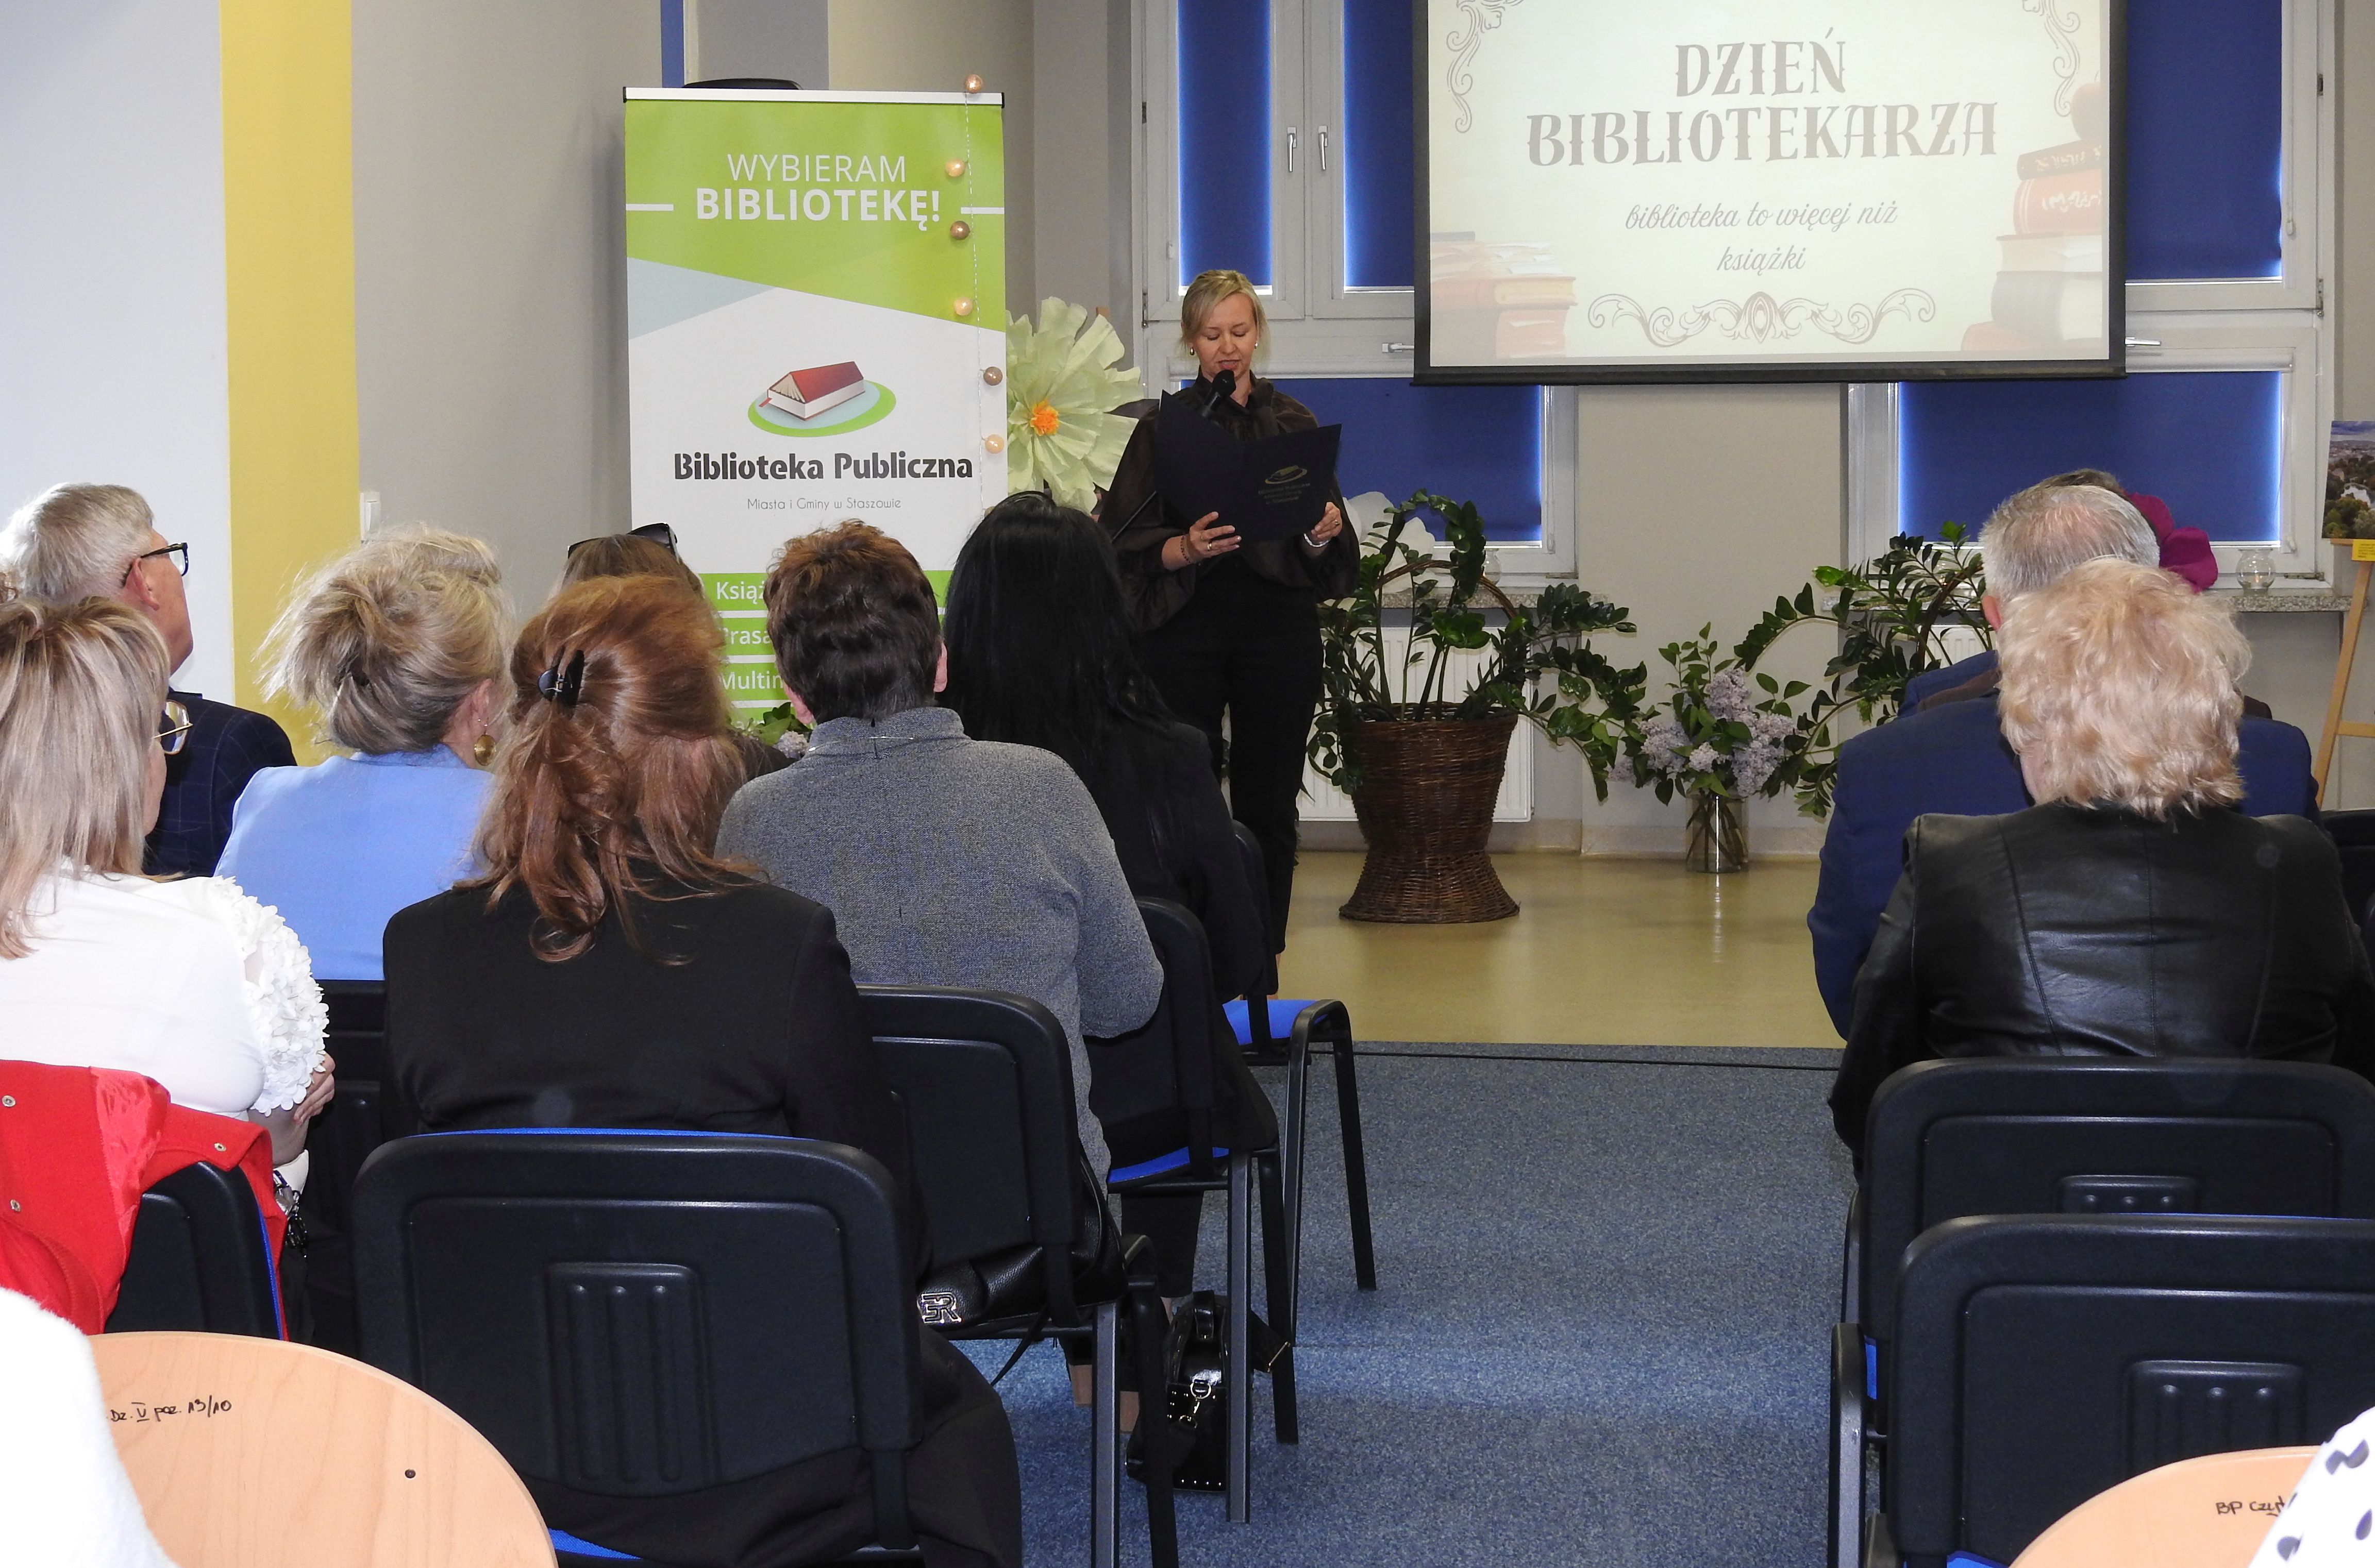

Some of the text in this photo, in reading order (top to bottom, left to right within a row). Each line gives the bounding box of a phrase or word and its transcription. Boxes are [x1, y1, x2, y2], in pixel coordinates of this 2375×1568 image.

[1675, 27, 1846, 97] DZIEŃ
[1527, 102, 1998, 166] BIBLIOTEKARZA
[727, 154, 906, 182] WYBIERAM
[697, 188, 940, 231] BIBLIOTEKĘ!
[1626, 200, 1898, 232] biblioteka to więcej niż
[1716, 245, 1806, 276] książki
[674, 451, 973, 480] Biblioteka Publiczna
[747, 498, 785, 509] Miasta
[790, 499, 792, 509] i
[797, 498, 829, 511] Gminy
[846, 497, 901, 509] Staszowie
[2216, 1501, 2243, 1514] BP
